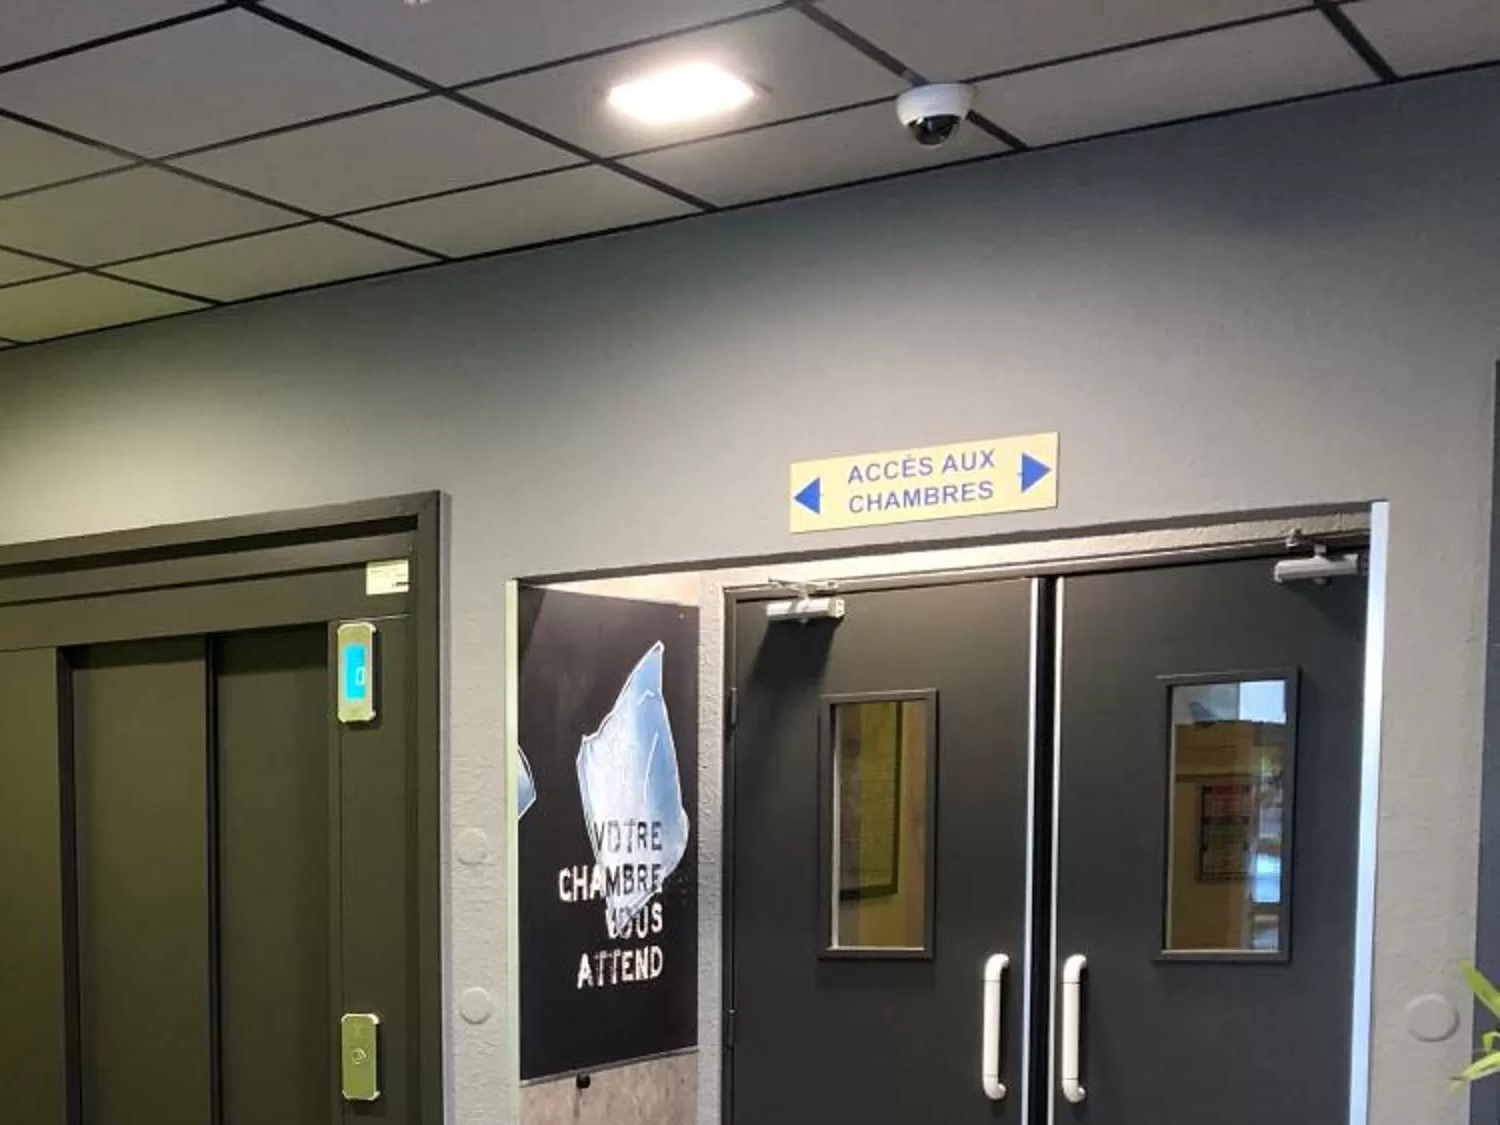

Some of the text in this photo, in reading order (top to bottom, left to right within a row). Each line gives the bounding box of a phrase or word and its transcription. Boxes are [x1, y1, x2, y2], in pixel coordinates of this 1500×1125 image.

[847, 449, 995, 484] ACCÈS AUX
[848, 480, 994, 514] CHAMBRES
[593, 818, 663, 853] VOTRE
[558, 864, 663, 902] CHAMBRE
[605, 901, 664, 939] VOUS
[577, 945, 664, 989] ATTEND
